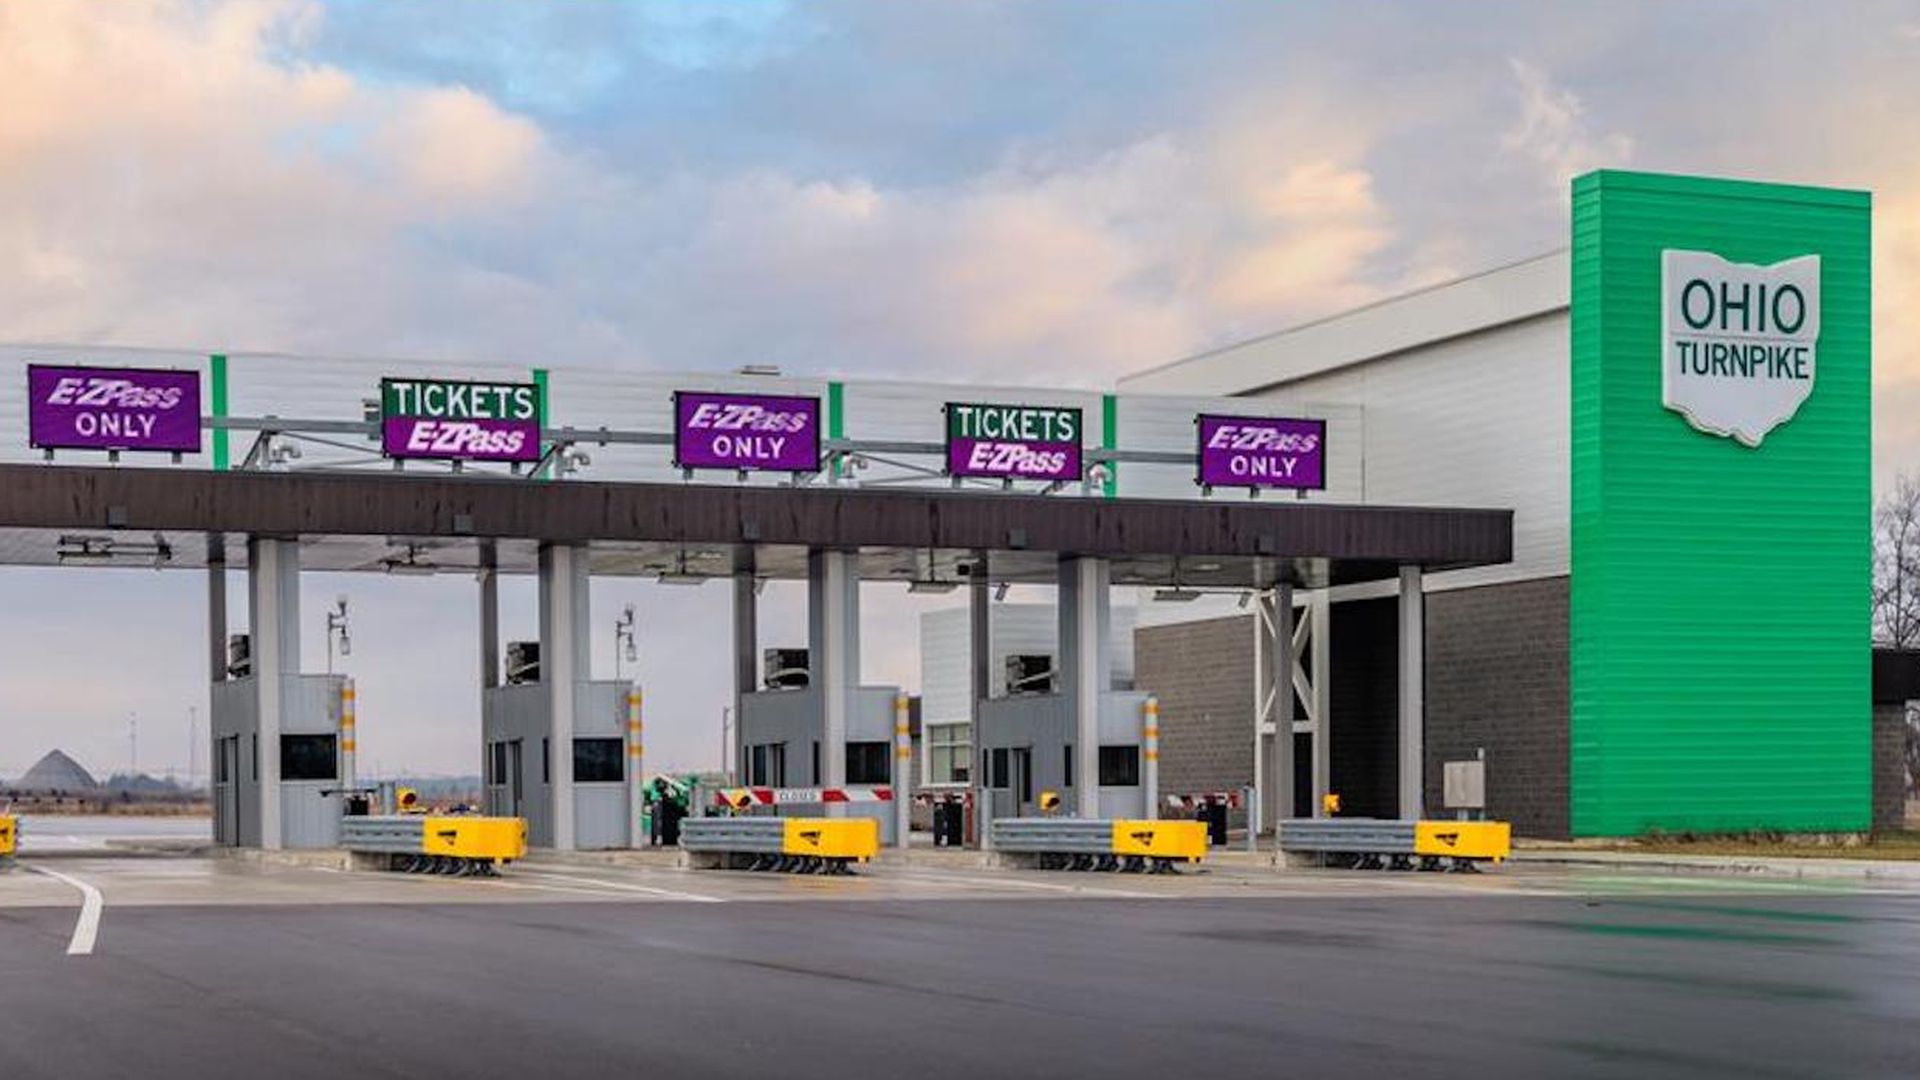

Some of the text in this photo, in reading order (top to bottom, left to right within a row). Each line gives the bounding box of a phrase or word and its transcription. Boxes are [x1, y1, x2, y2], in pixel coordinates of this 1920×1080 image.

[1681, 279, 1806, 334] OHIO
[1676, 341, 1809, 379] TURNPIKE
[391, 382, 534, 419] TICKETS
[75, 412, 157, 438] ONLY
[957, 407, 1074, 440] TICKETS
[713, 435, 786, 459] ONLY
[1230, 455, 1298, 477] ONLY
